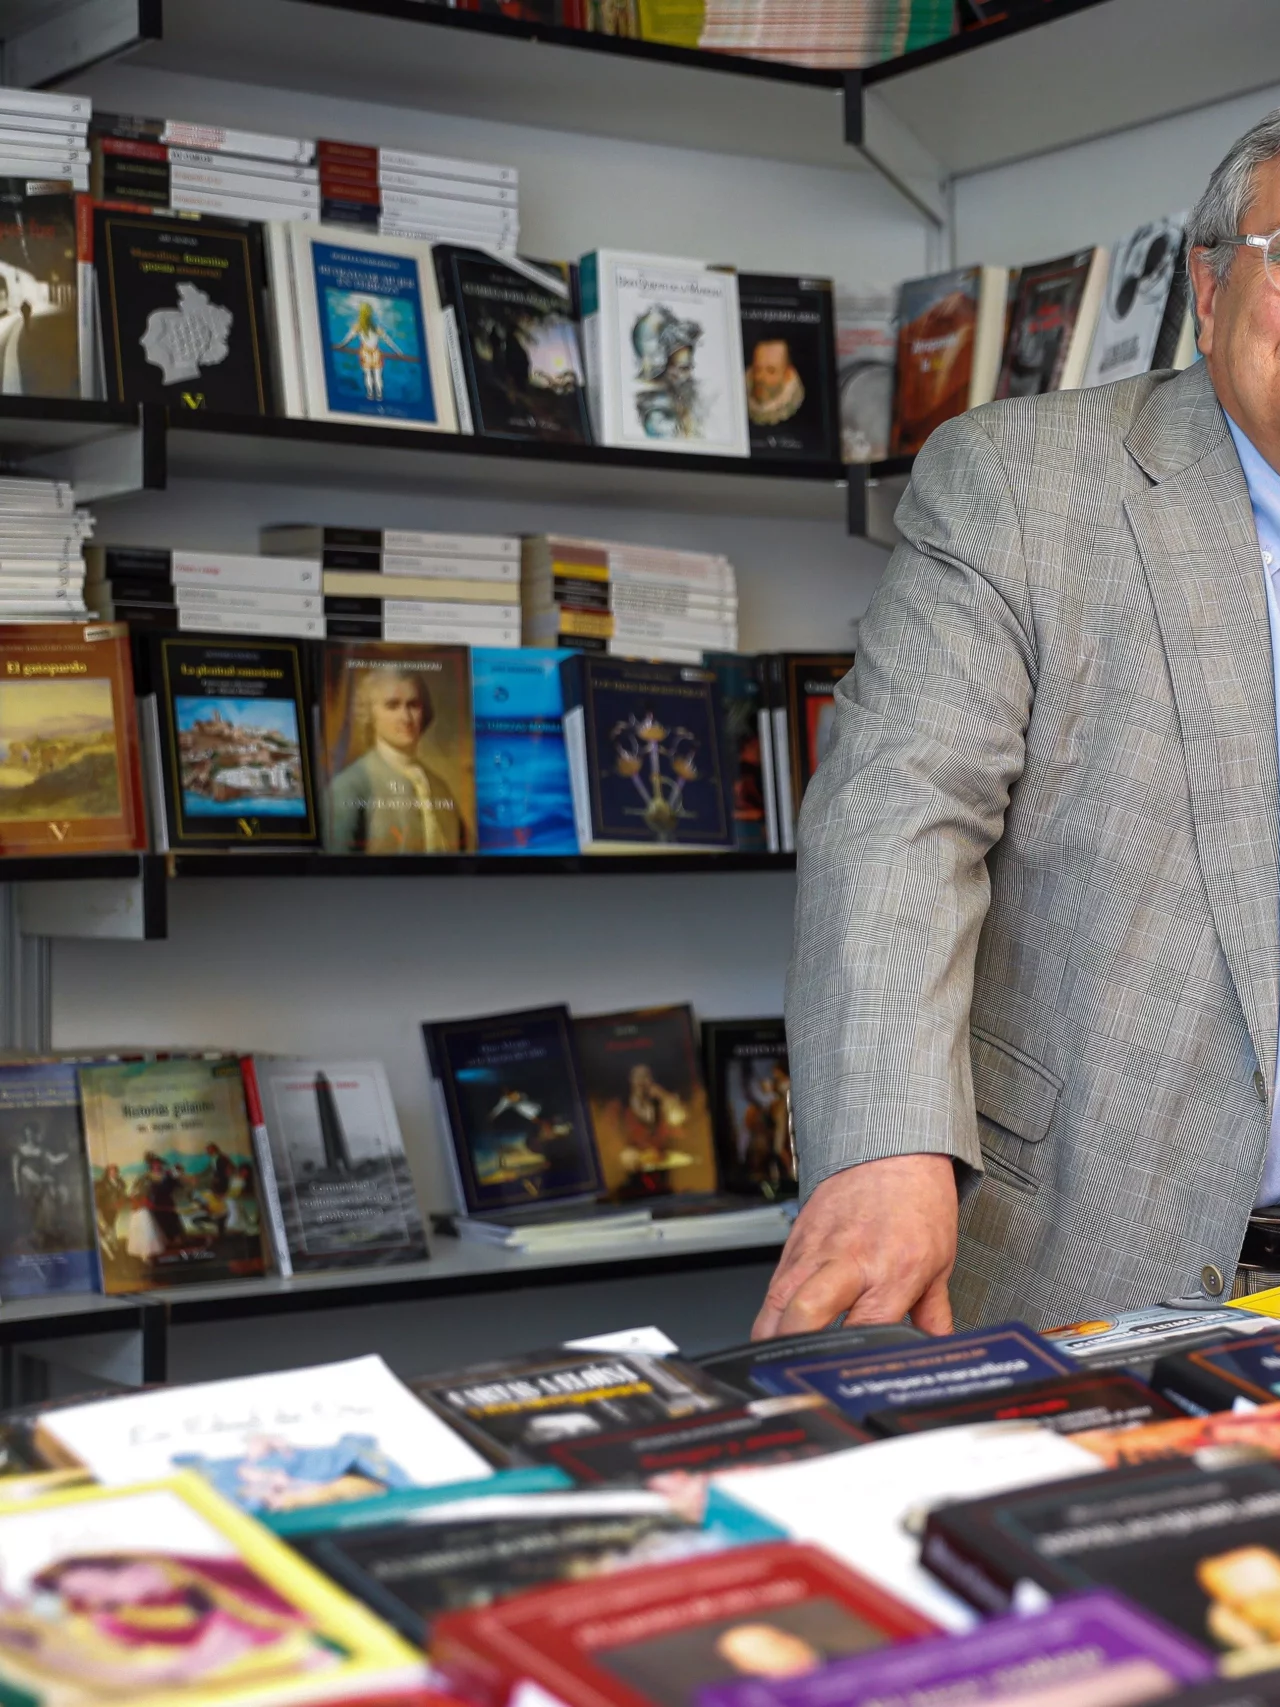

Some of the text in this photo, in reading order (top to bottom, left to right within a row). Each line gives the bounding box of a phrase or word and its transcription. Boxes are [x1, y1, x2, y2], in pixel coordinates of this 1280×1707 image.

[6, 660, 87, 677] El gatopardo
[180, 663, 195, 675] La
[48, 823, 70, 841] V
